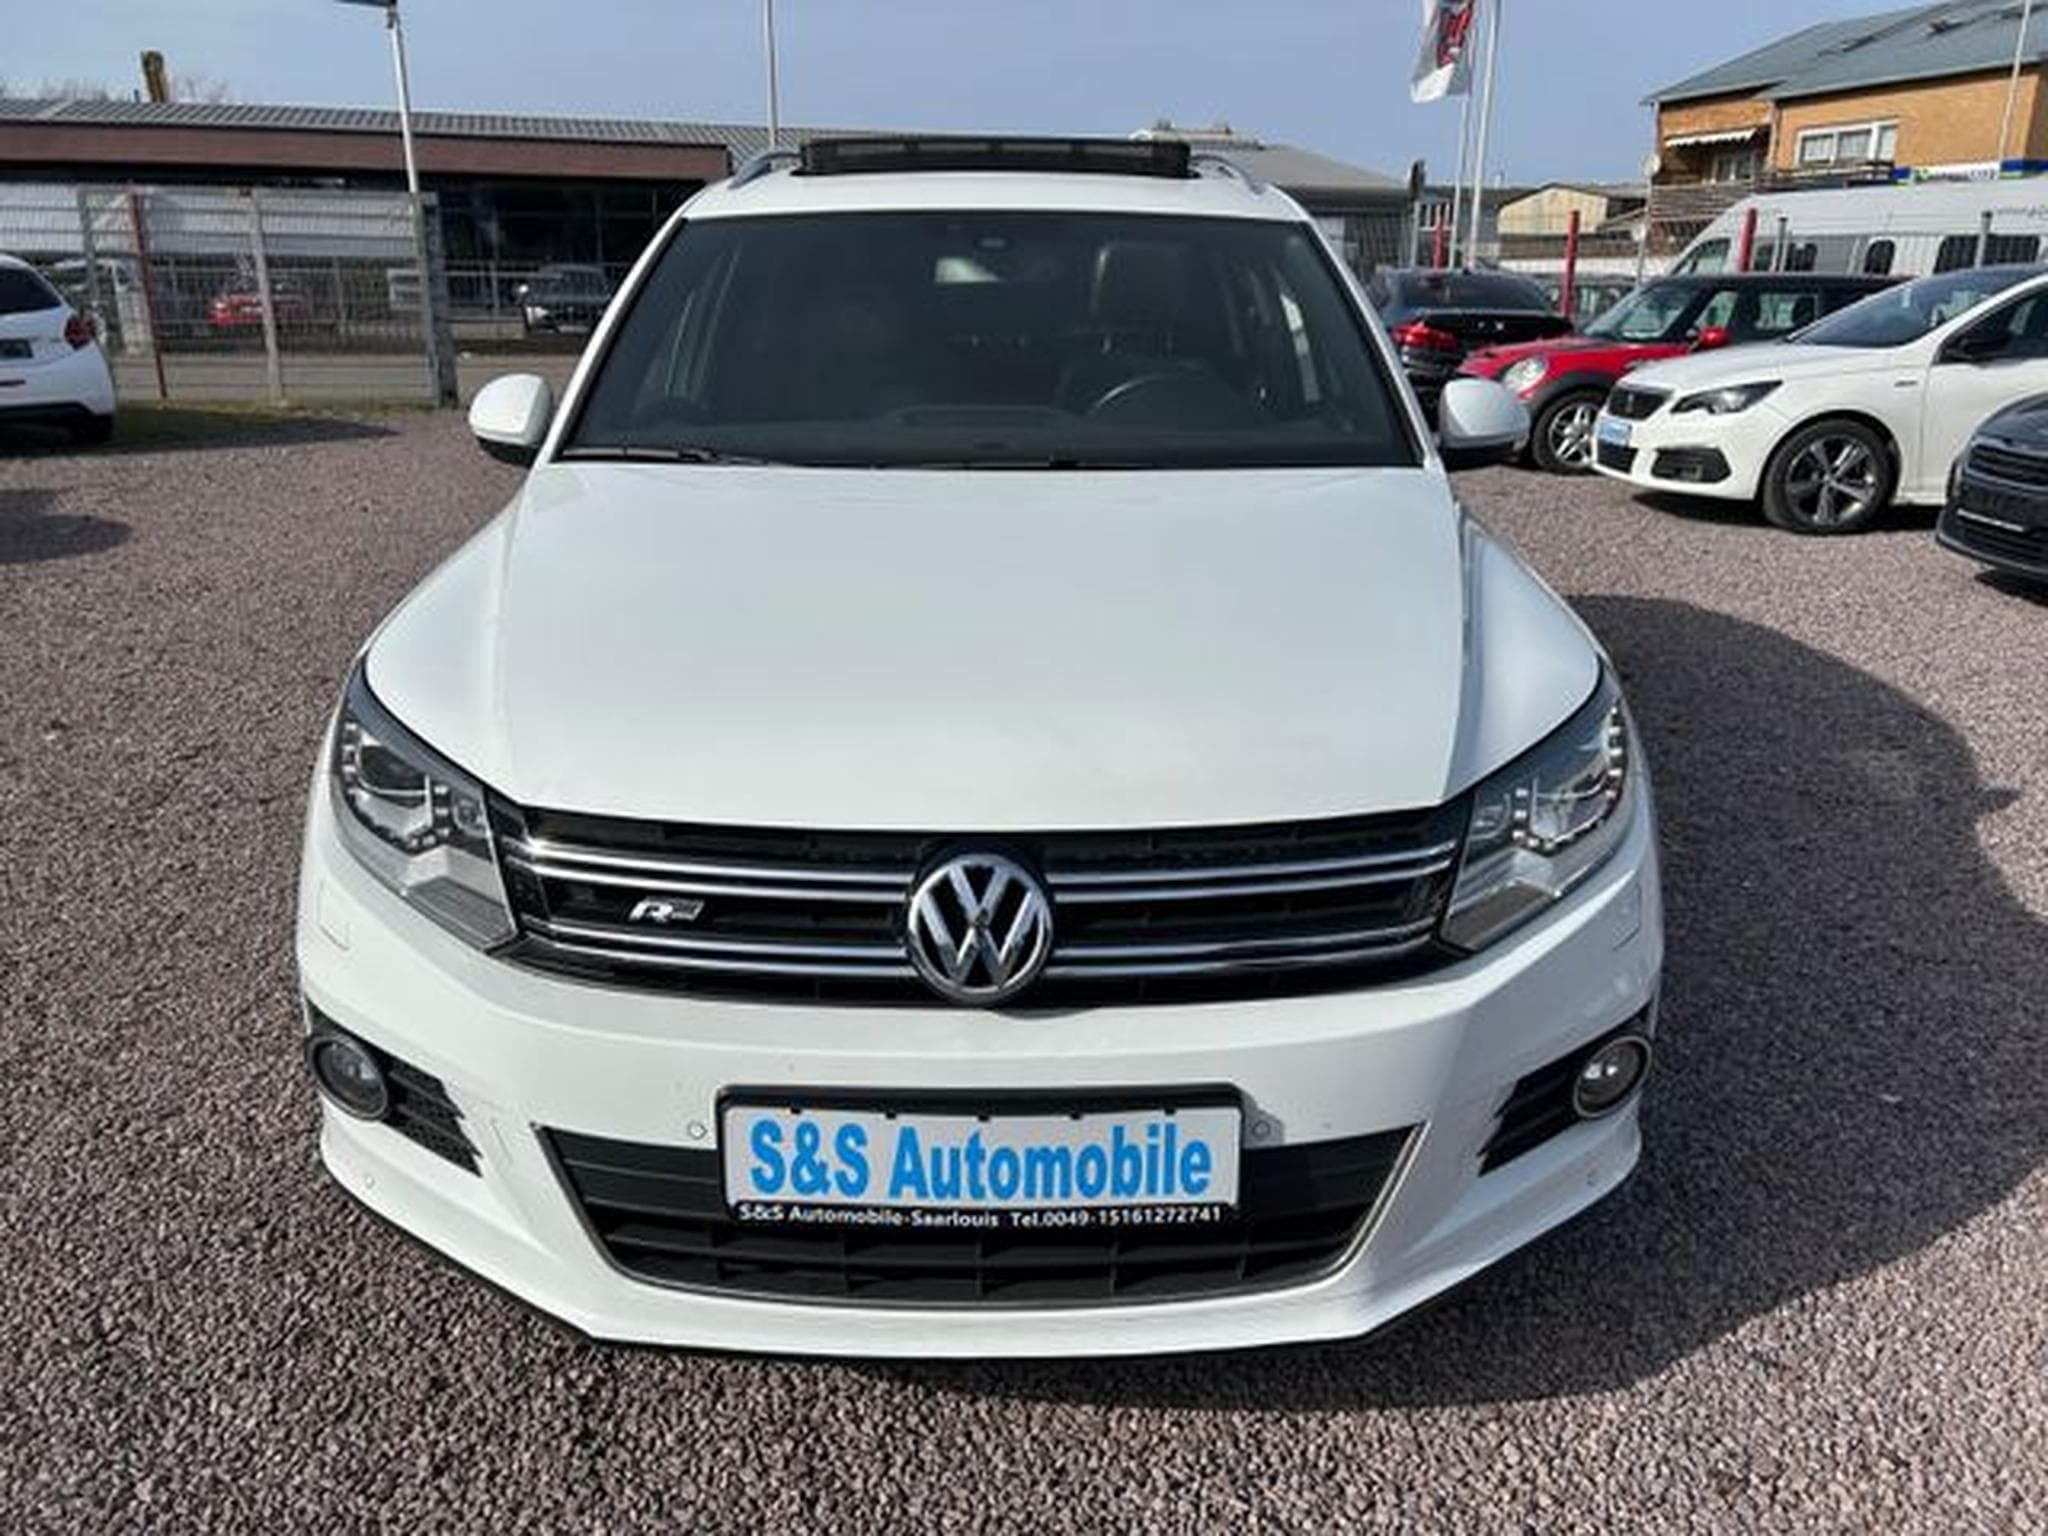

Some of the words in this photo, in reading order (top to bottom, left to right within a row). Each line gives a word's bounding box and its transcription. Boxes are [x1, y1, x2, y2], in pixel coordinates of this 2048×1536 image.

[750, 1119, 869, 1197] S&S
[889, 1122, 1212, 1200] Automobile
[738, 1204, 784, 1221] S&S
